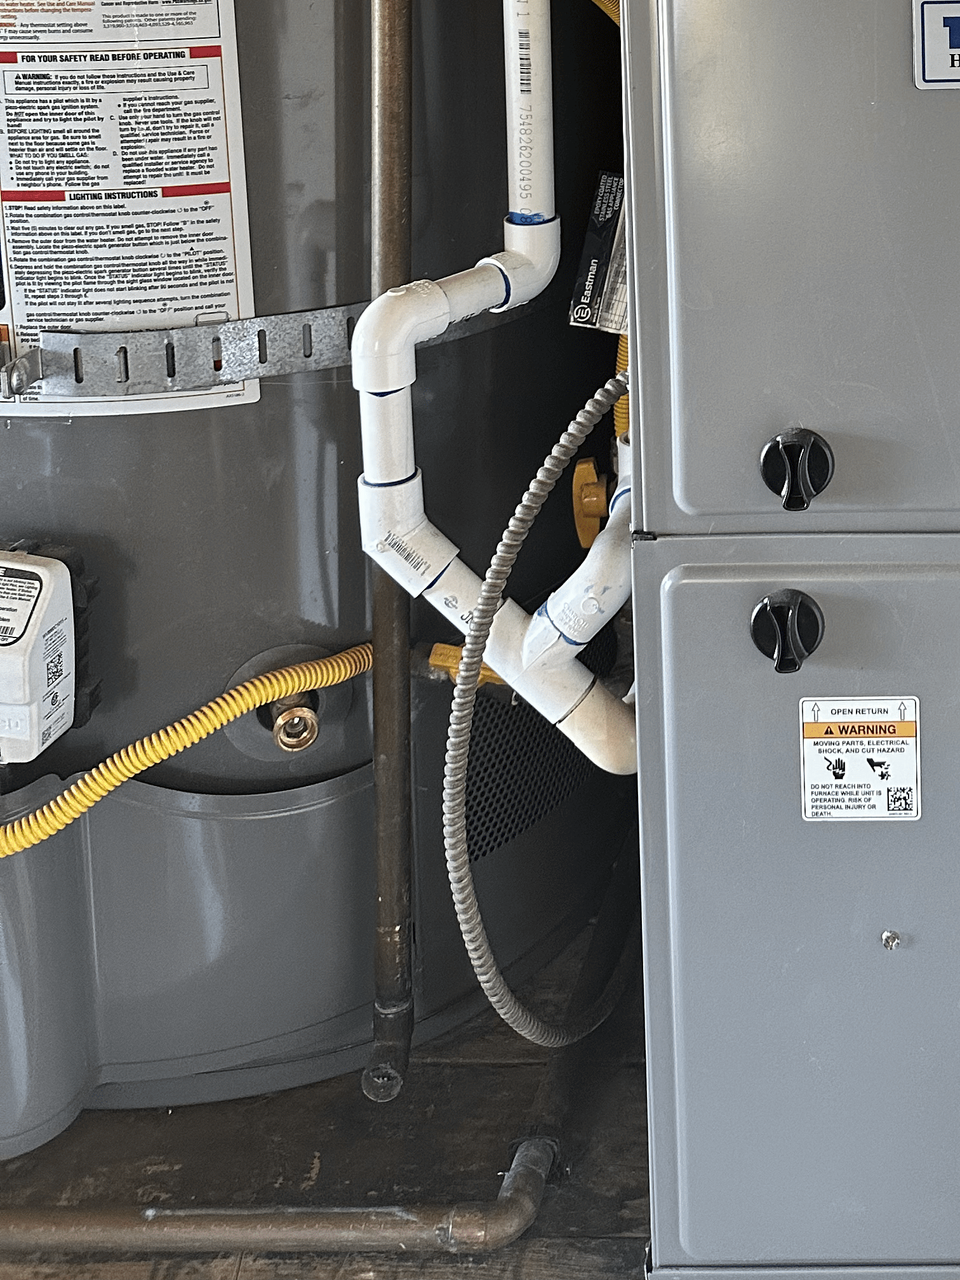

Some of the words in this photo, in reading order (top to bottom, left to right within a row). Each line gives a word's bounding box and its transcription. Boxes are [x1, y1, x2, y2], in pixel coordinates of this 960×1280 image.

[21, 54, 36, 63] FOR
[37, 54, 57, 63] YOUR
[59, 54, 89, 62] SAFETY
[90, 53, 110, 61] READ
[112, 52, 142, 61] BEFORE
[143, 51, 186, 60] OPERATING
[69, 193, 103, 201] LIGHTING
[104, 190, 159, 200] INSTRUCTIONS
[599, 191, 611, 222] STAINLESS
[606, 176, 614, 192] STEEL
[580, 258, 599, 304] Eastman
[855, 707, 889, 715] RETURN
[838, 724, 897, 735] WARNING
